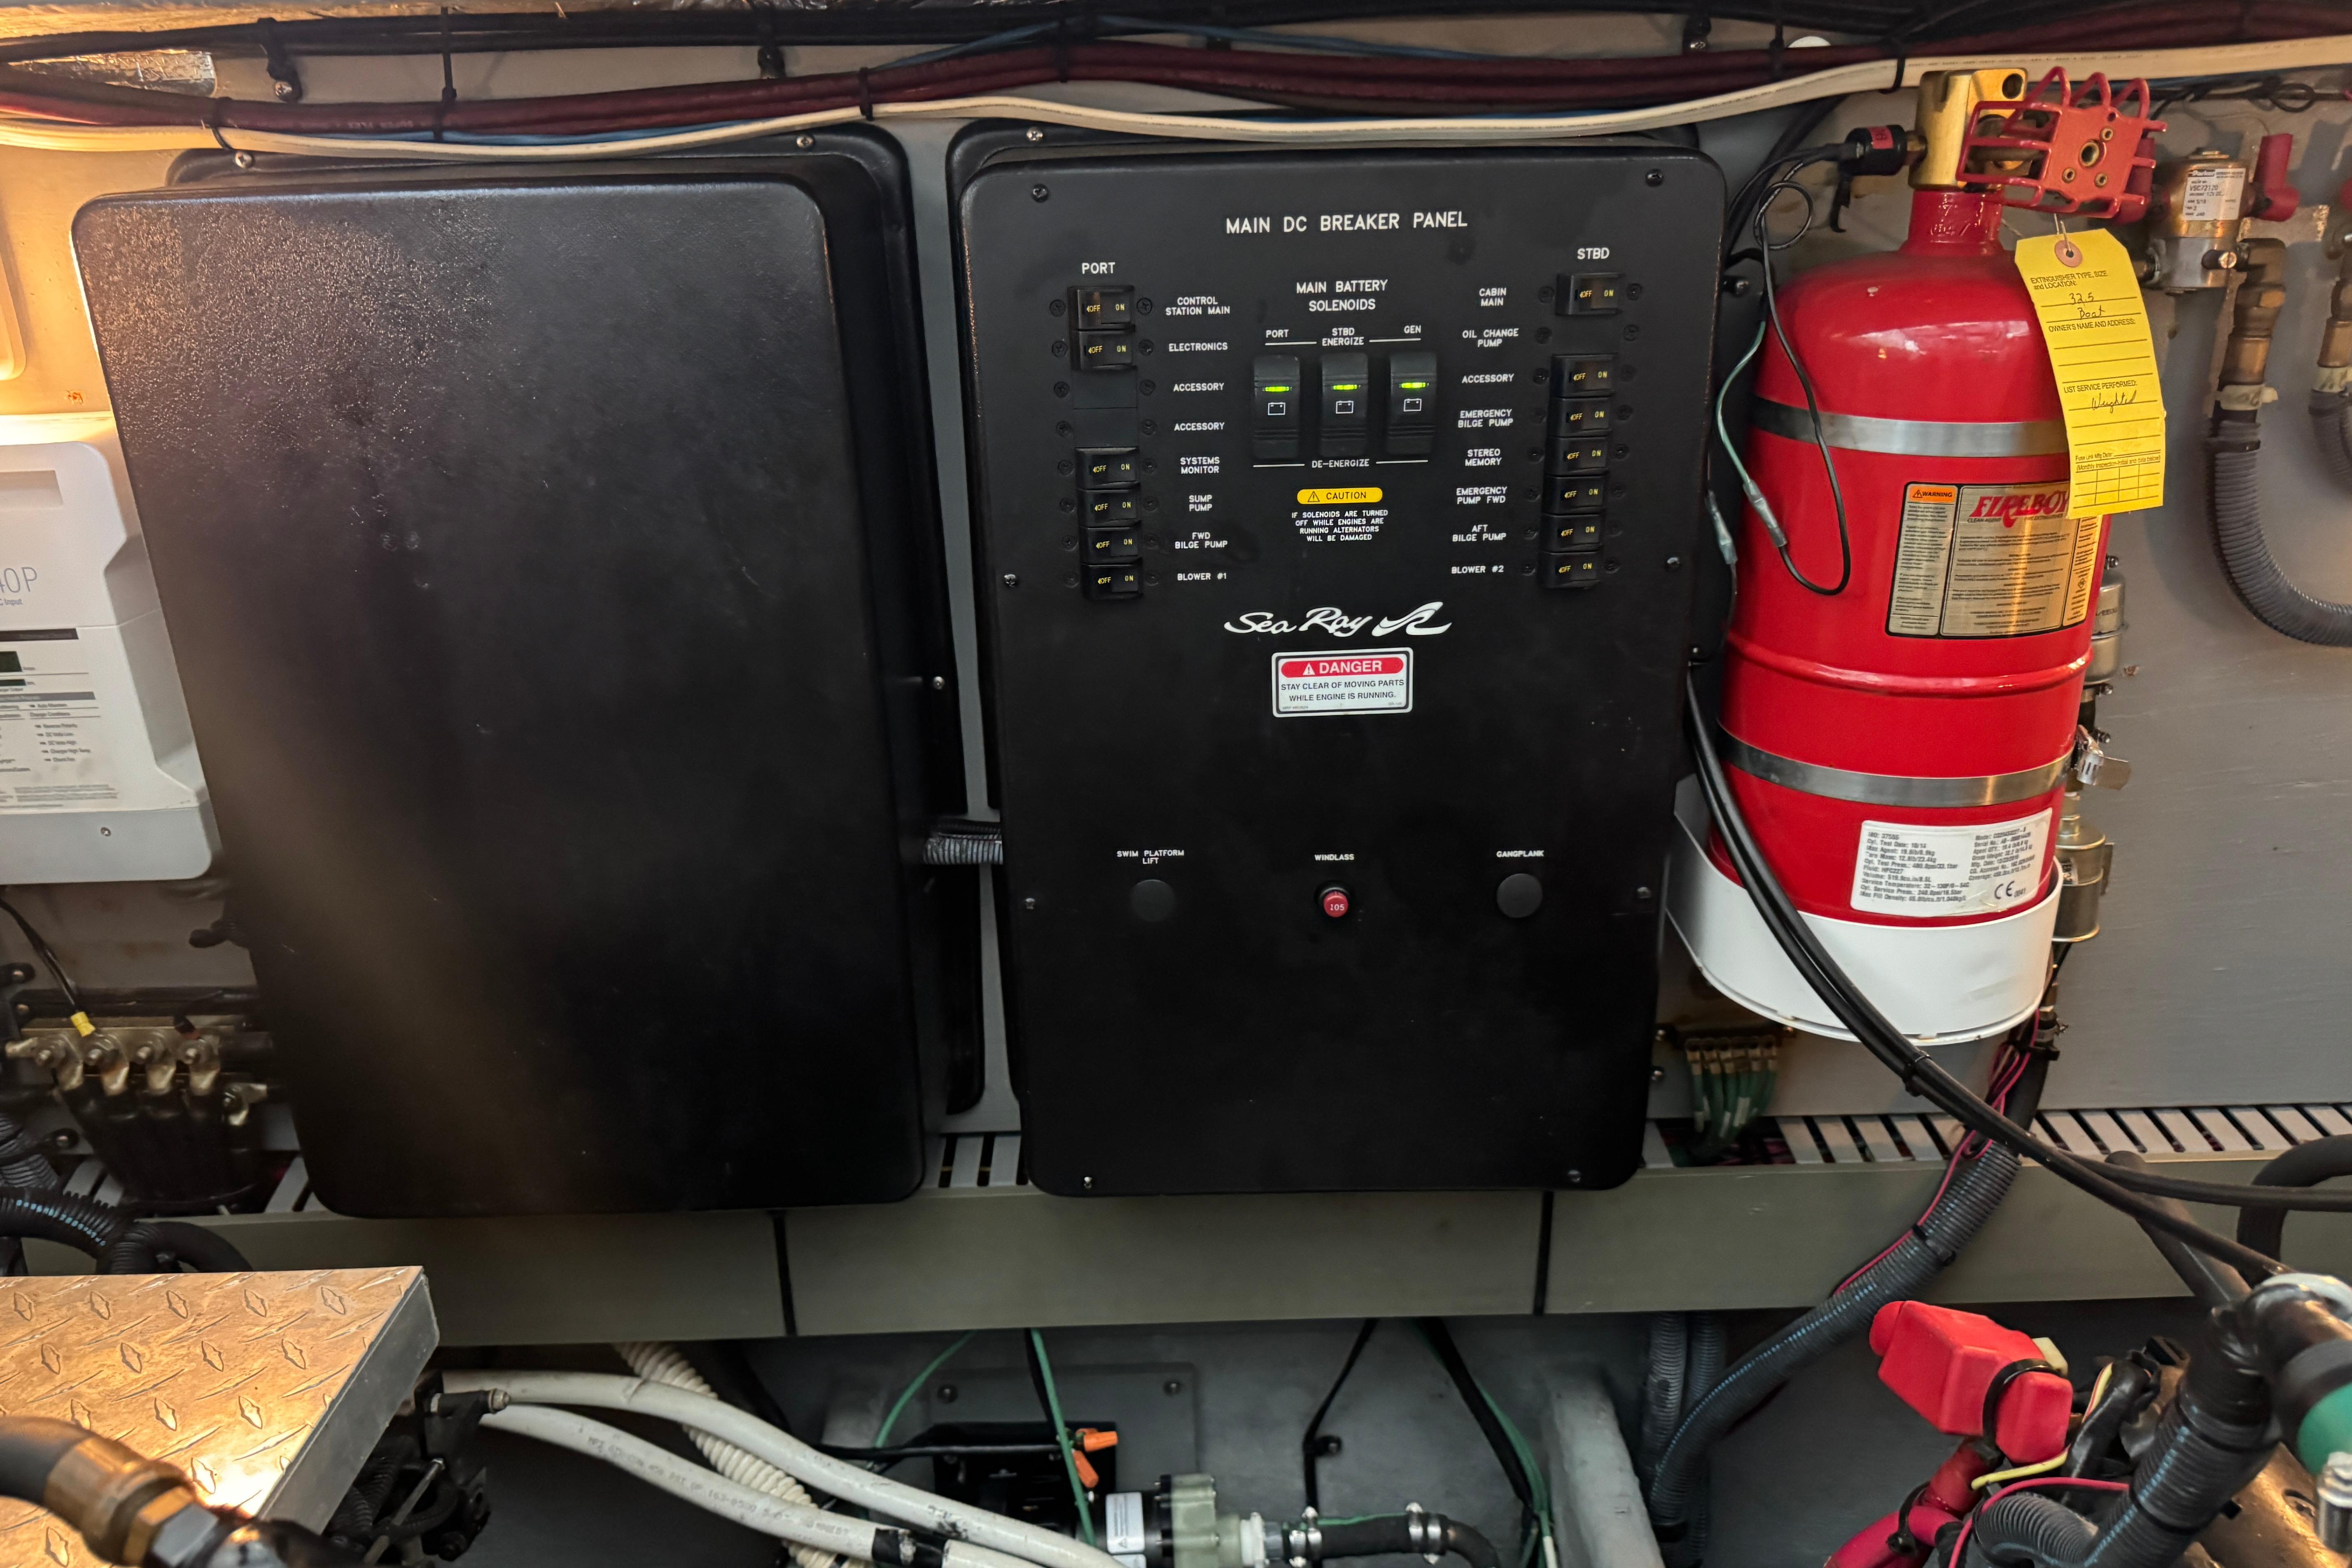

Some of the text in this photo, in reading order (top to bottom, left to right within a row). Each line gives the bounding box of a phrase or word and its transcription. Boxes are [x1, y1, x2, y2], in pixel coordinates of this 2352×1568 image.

[1227, 211, 1467, 233] MAIN DC BREAKER PANEL
[1577, 247, 1609, 259] STBD
[1082, 262, 1115, 274] PORT
[2030, 274, 2076, 283] EXTINGUISHER
[1297, 280, 1388, 293] MAIN BATTERY
[1479, 288, 1506, 296] CABIN
[1177, 296, 1218, 305] CONTROL
[1481, 298, 1503, 306] MAIN
[2069, 292, 2094, 304] 32.5
[1309, 299, 1375, 311] SOLENOIDS
[1166, 307, 1202, 315] STATION
[2077, 305, 2105, 319] Boat
[1404, 325, 1421, 334] GEN
[1484, 328, 1519, 337] CHANGE
[2049, 324, 2076, 332] OWNER'S
[1266, 329, 1288, 338] PORT
[1332, 328, 1354, 338] STBD
[1322, 337, 1364, 346] ENERGIZE
[1478, 338, 1502, 347] PUMP
[1169, 342, 1227, 352] ELECTRONICS
[1462, 374, 1514, 383] ACCESSORY
[1174, 383, 1224, 391] ACCESSORY
[1460, 409, 1513, 420] EMERGENCY
[1174, 422, 1224, 431] ACCESSORY
[1458, 419, 1483, 428] BILGE
[1468, 448, 1502, 458] STEREO
[1181, 457, 1220, 465] SYSTEMS
[1312, 459, 1369, 468] DE-ENERGIZE
[1465, 457, 1502, 466] MEMORY
[1456, 487, 1507, 497] EMERGENCY
[1472, 525, 1488, 534] AFT
[1224, 607, 1373, 637] Sea Ray
[1320, 660, 1381, 674] DANGER
